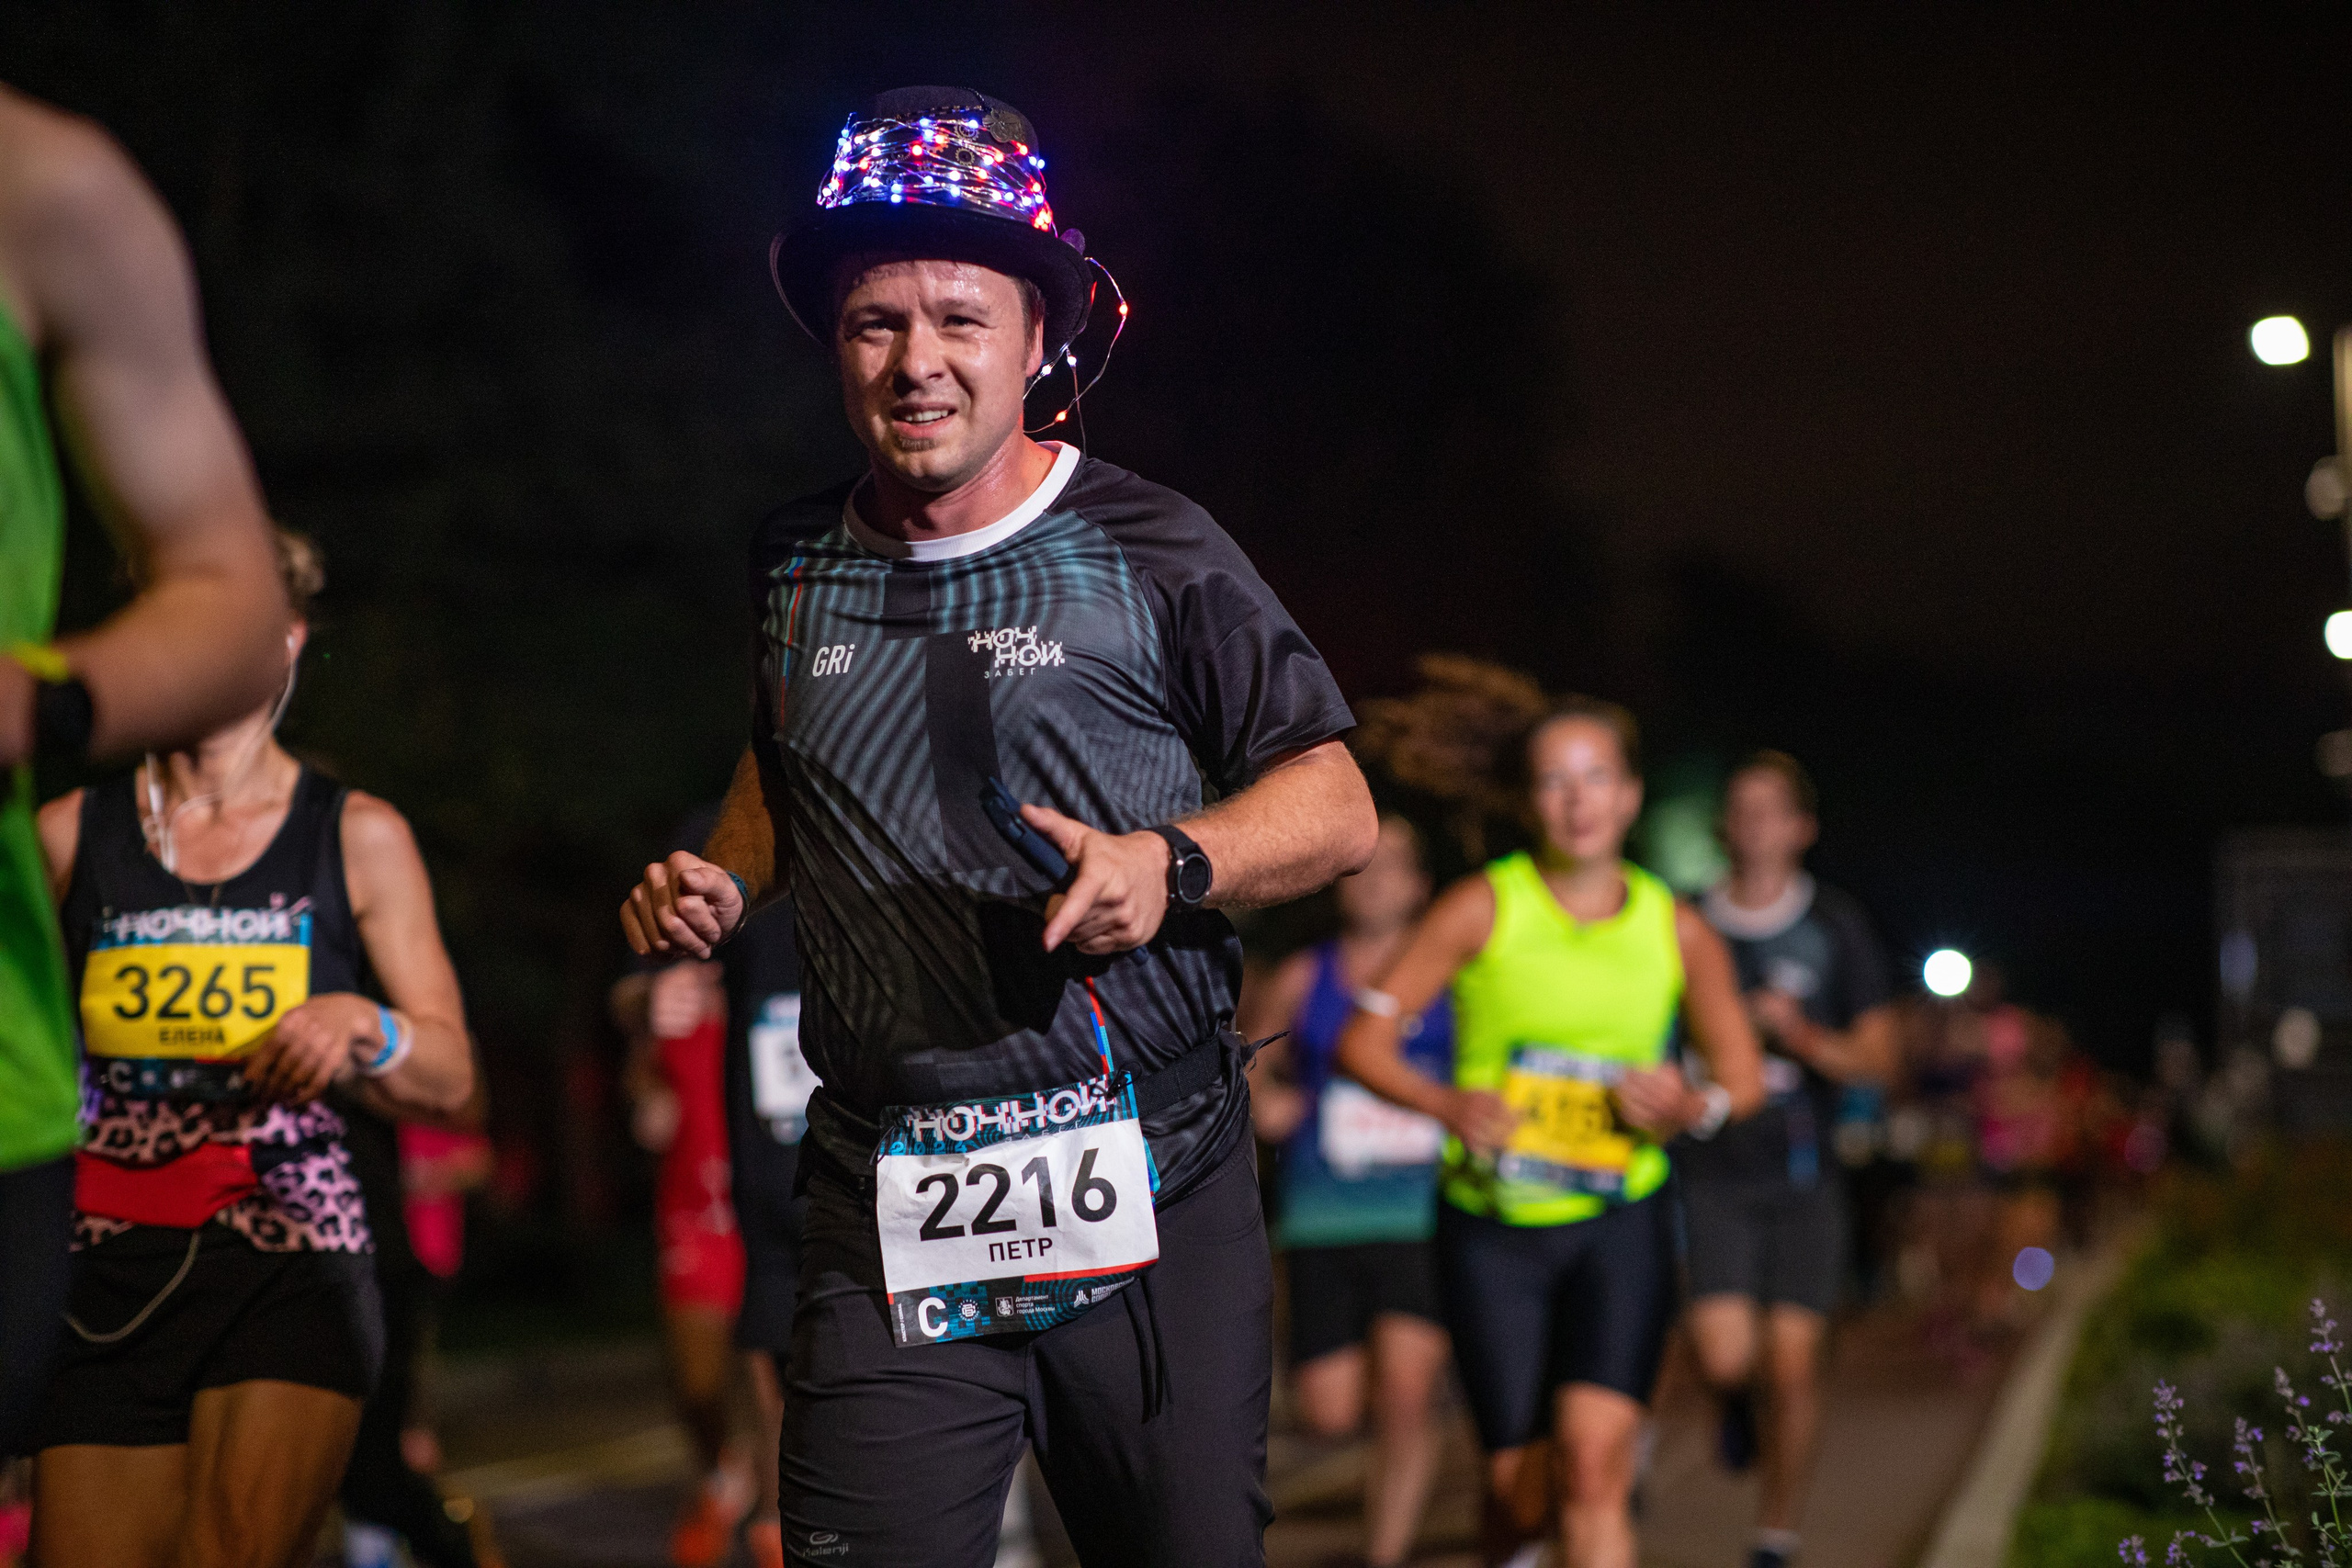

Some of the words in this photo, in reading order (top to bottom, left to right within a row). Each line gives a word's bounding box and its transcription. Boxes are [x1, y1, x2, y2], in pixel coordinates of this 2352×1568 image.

[967, 626, 1037, 653] НОЧ
[812, 644, 855, 677] GRi
[984, 667, 1036, 679] ЗАБЕГ
[112, 964, 276, 1020] 3265
[158, 1027, 226, 1045] ЕЛЕНА
[905, 1074, 1115, 1142] НОЧНОЙ
[915, 1147, 1117, 1242] 2216
[989, 1237, 1054, 1262] ПЕТР
